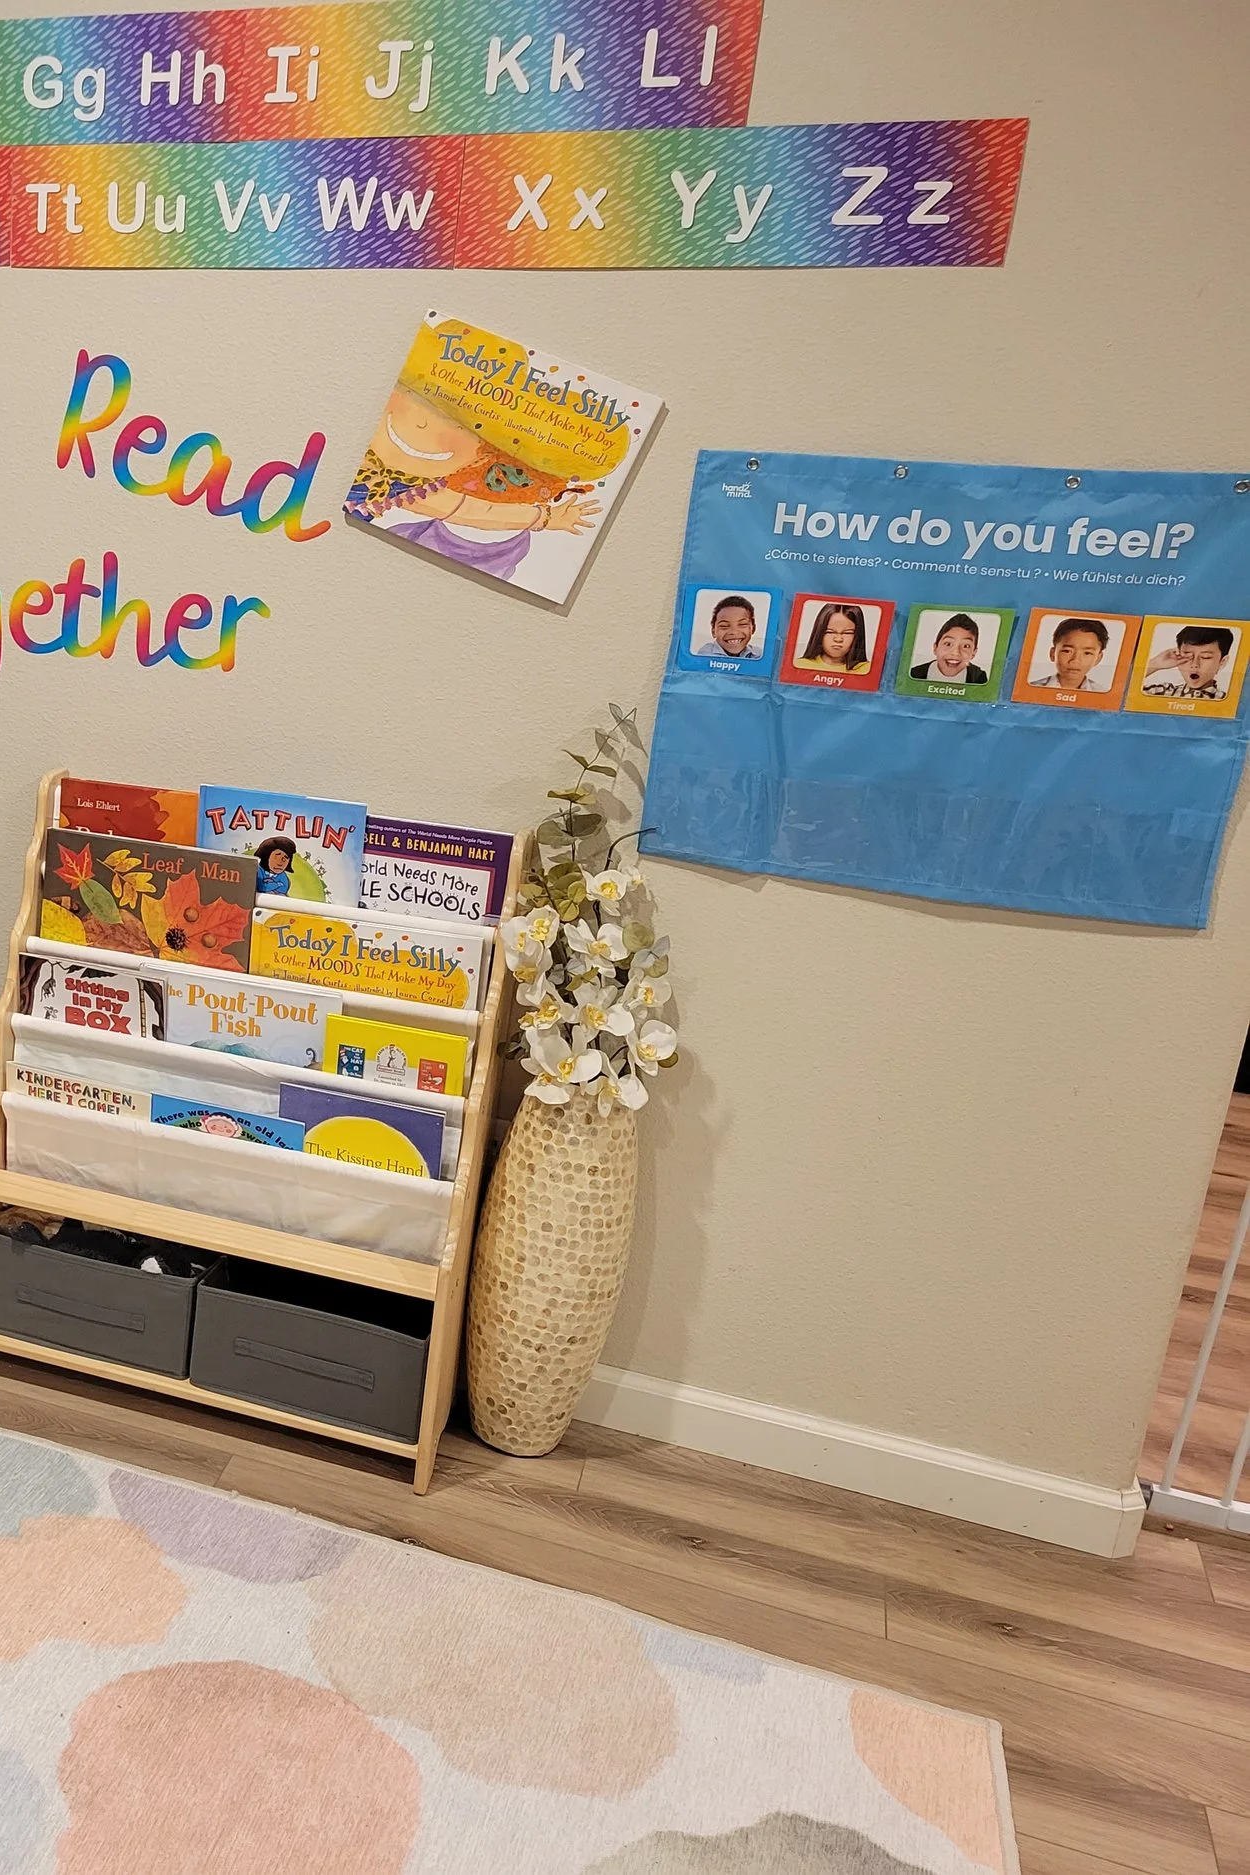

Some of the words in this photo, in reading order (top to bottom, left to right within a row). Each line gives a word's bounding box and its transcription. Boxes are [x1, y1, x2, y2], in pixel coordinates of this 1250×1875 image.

[438, 333, 507, 380] Today
[504, 360, 525, 386] I
[520, 367, 571, 406] Feel
[572, 388, 631, 433] Silly
[423, 383, 431, 394] by
[432, 385, 457, 402] Jamie
[457, 395, 472, 410] Lee
[473, 403, 500, 421] Curtis
[504, 418, 538, 437] illustrated
[537, 431, 546, 442] by
[546, 432, 570, 450] Laura
[572, 442, 608, 466] Cornell
[430, 363, 438, 377] &
[438, 367, 464, 388] Other
[463, 376, 524, 411] MOODS
[522, 400, 545, 421] That
[545, 412, 576, 431] Make
[576, 424, 594, 442] My
[594, 431, 617, 451] Day
[56, 348, 332, 542] Read
[773, 502, 880, 542] How
[887, 509, 952, 546] do
[961, 520, 1056, 560] you
[1067, 517, 1195, 559] feel?
[764, 548, 810, 562] ¿Cómo
[812, 553, 825, 563] te
[828, 553, 882, 568] sientes?
[891, 558, 961, 574] Comment
[964, 564, 977, 575] te
[980, 566, 1030, 579] sens-tu
[1053, 569, 1079, 582] Wie
[1082, 571, 1121, 584] fühlst
[1124, 573, 1143, 585] du
[1145, 573, 1186, 586] dich?
[709, 660, 741, 672] Happy
[813, 674, 844, 686] Angry
[927, 685, 965, 696] Excited
[1055, 692, 1077, 702] Sad
[1167, 701, 1195, 711] Tired
[77, 798, 94, 808] Lois
[96, 800, 121, 812] Ehlert
[205, 804, 356, 852] TATTLIN'
[141, 852, 184, 874] Leaf
[201, 861, 241, 883] Man
[391, 837, 401, 848] &
[406, 838, 463, 857] BENJAMIN
[468, 846, 496, 862] HART
[361, 859, 388, 877] orld
[442, 872, 478, 895] More
[387, 882, 481, 920] SCHOOLS
[270, 925, 337, 957] Today
[340, 935, 352, 957] I
[356, 937, 401, 964] Feel
[406, 944, 461, 978] Silly
[273, 952, 281, 963] &
[281, 953, 306, 968] Other
[307, 956, 362, 978] MOODS
[364, 965, 386, 980] That
[387, 969, 416, 984] Make
[418, 974, 435, 989] My
[436, 977, 457, 993] Day
[306, 973, 321, 985] Lee
[322, 976, 348, 989] Curtis
[395, 988, 418, 1000] Laura
[64, 1006, 132, 1035] BOX
[167, 984, 183, 998] he
[186, 983, 319, 1025] Pout-Pout
[209, 1010, 262, 1038] Fish
[16, 1068, 136, 1110] KINDERGARTEN,
[28, 1085, 61, 1103] HERE
[66, 1094, 74, 1106] I
[154, 1111, 184, 1124] There
[187, 1109, 210, 1117] was
[237, 1116, 252, 1127] an
[255, 1126, 275, 1139] old
[305, 1141, 331, 1158] The
[336, 1148, 382, 1169] Kissing
[386, 1158, 424, 1177] Hand
